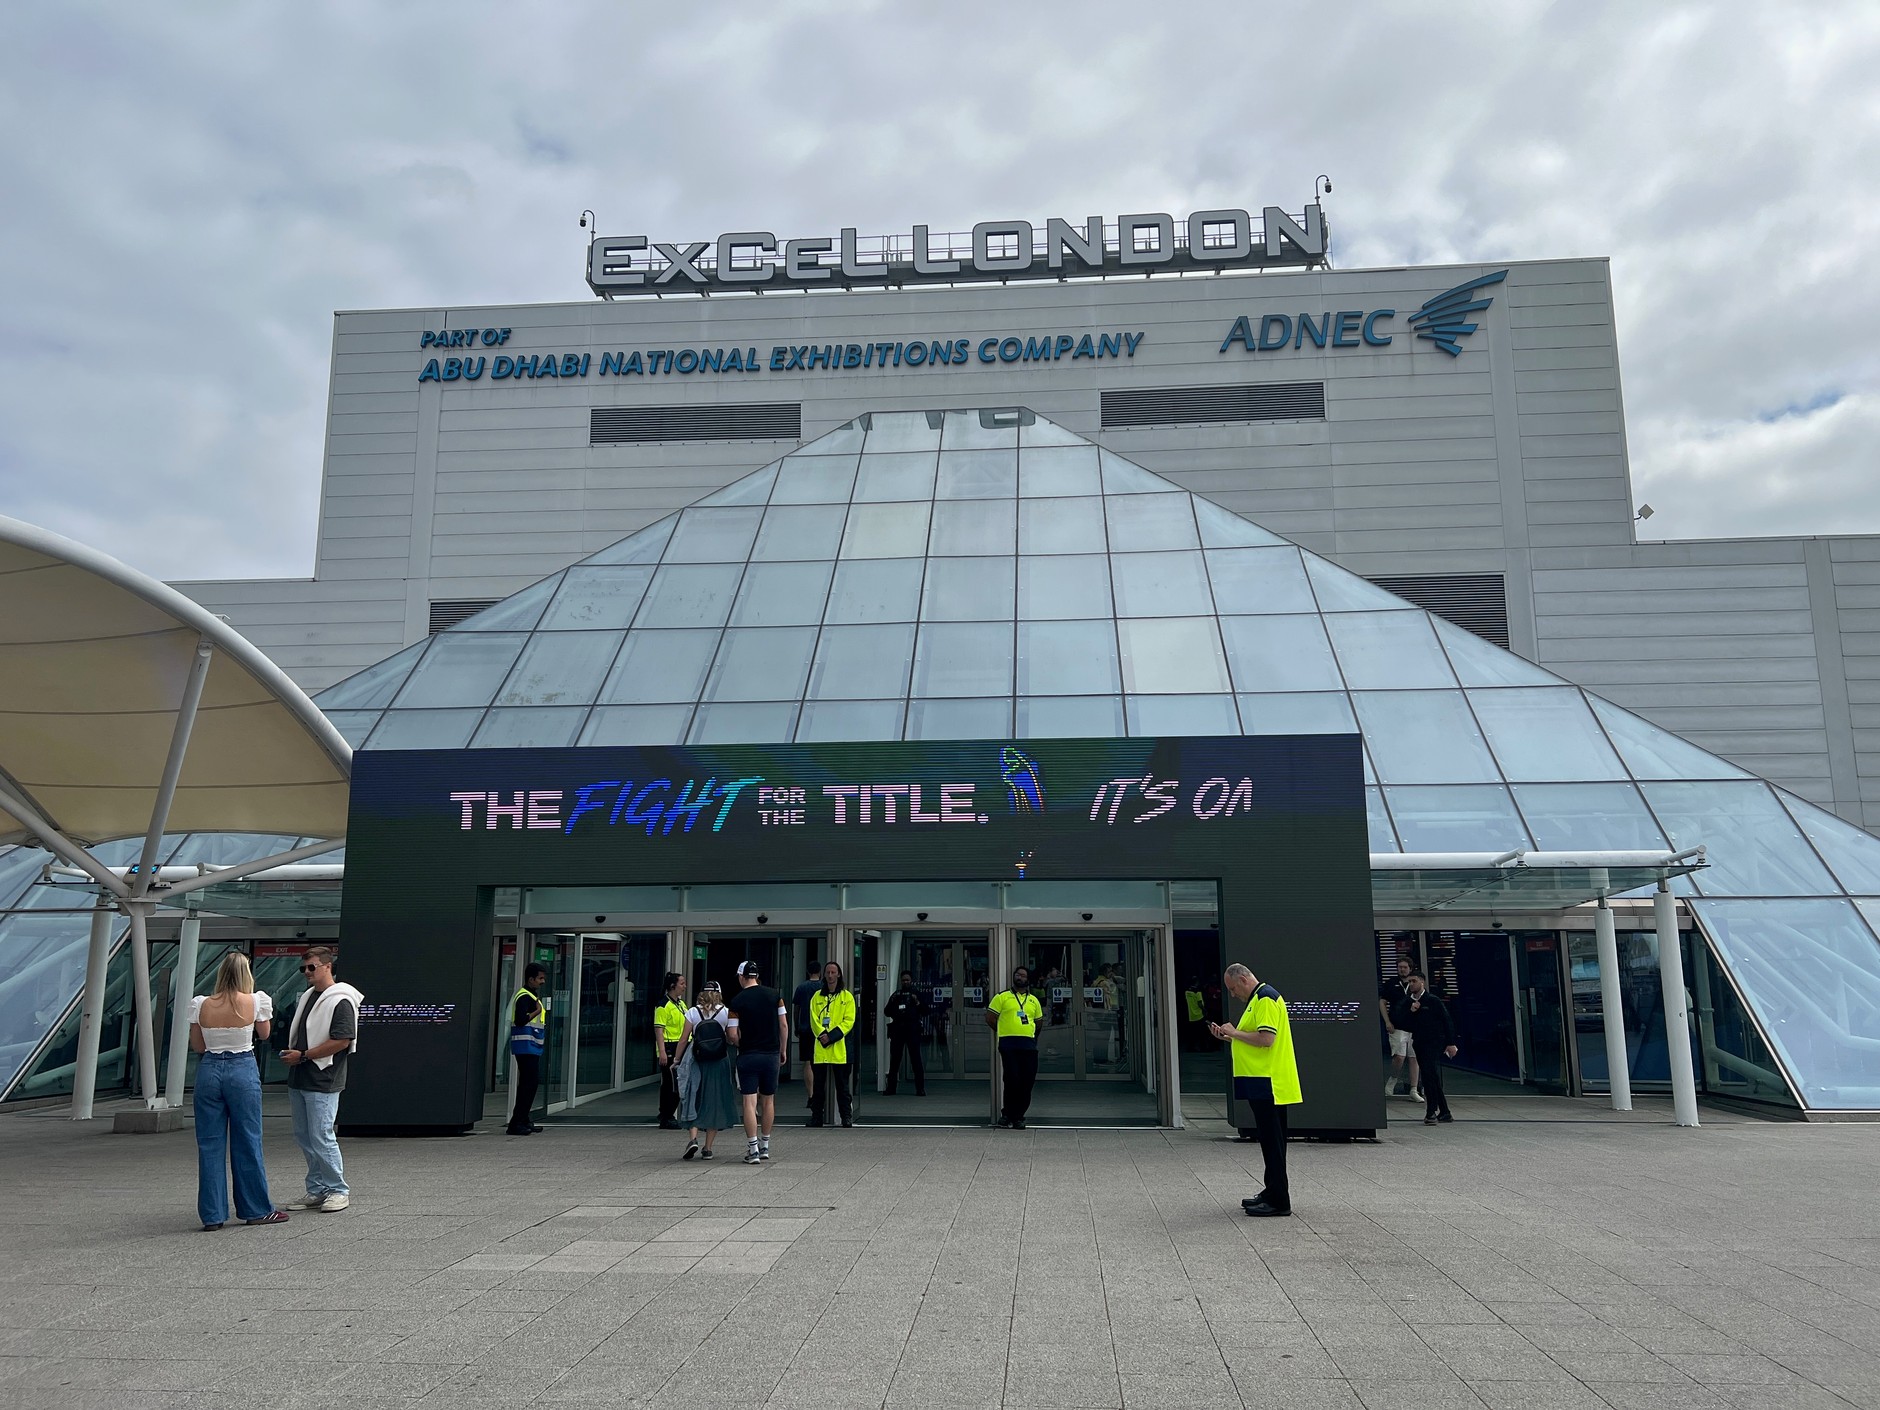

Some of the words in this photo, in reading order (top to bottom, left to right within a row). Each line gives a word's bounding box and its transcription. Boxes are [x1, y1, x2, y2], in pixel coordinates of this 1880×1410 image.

[912, 204, 1323, 274] LONDON
[420, 329, 478, 348] PART
[480, 327, 511, 346] OF
[1219, 309, 1395, 353] ADNEC
[418, 356, 486, 383] ABU
[490, 352, 591, 380] DHABI
[599, 347, 761, 377] NATIONAL
[769, 339, 969, 371] EXHIBITIONS
[977, 332, 1145, 363] COMPANY
[449, 790, 563, 830] THE
[564, 776, 766, 836] FIGHT
[758, 786, 807, 804] FOR
[758, 809, 806, 825] THE
[823, 783, 989, 825] TITLE.
[1089, 773, 1179, 825] IT'S
